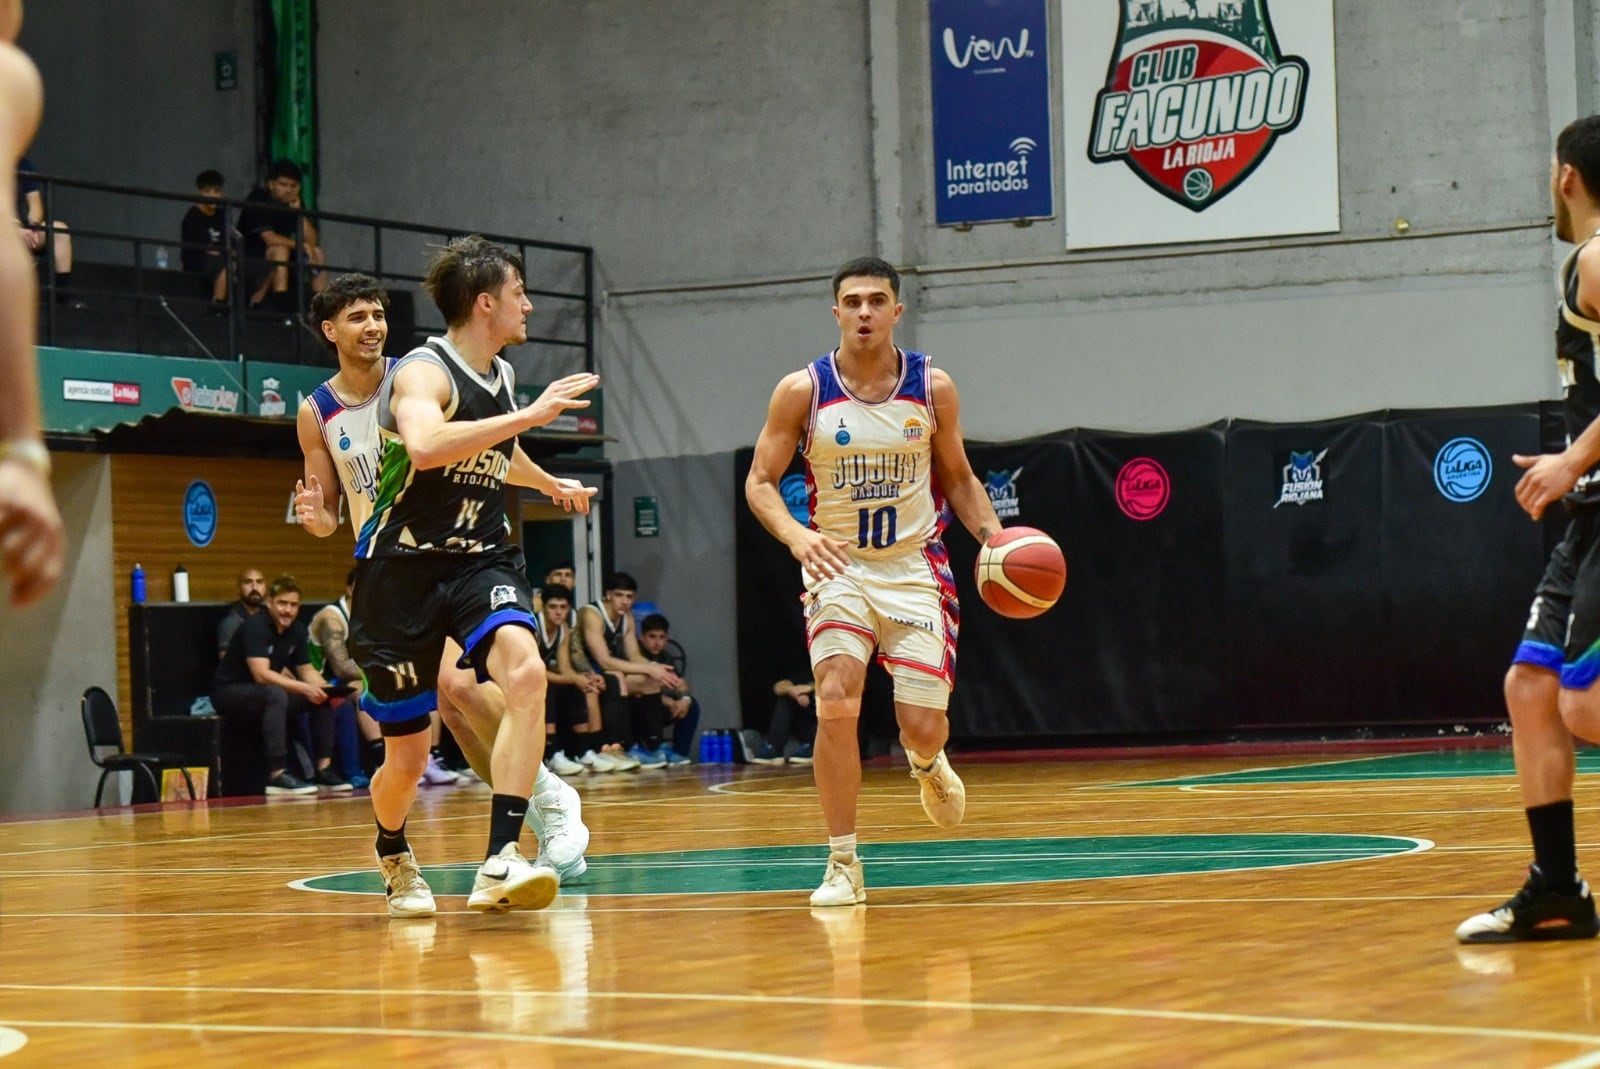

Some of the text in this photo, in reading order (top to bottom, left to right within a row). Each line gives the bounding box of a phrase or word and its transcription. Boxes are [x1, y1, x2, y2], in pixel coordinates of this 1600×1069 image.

[943, 27, 1029, 68] View
[1131, 45, 1198, 88] CLUB
[1095, 64, 1301, 155] FACUNDO
[946, 155, 1029, 181] Internet
[1162, 138, 1236, 170] LA RIOJA
[831, 452, 920, 489] JUJUY
[1281, 480, 1323, 493] FUSION
[851, 483, 900, 501] BASQUET
[1280, 490, 1323, 503] RIOJANA
[857, 505, 897, 549] 10
